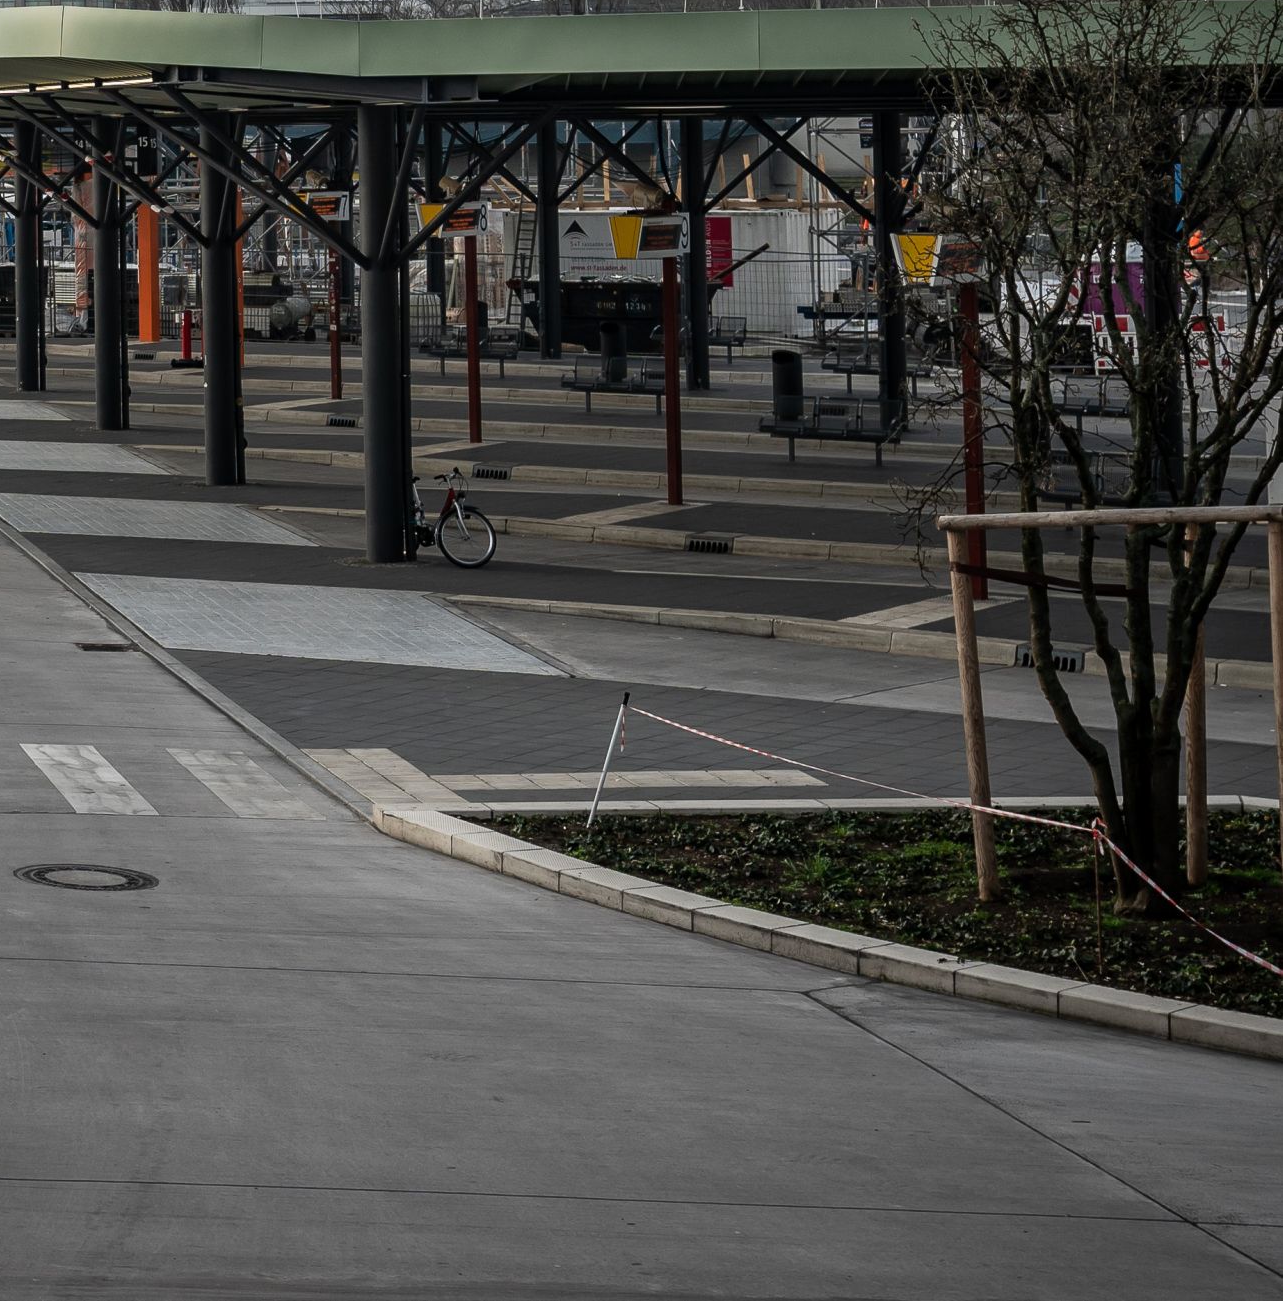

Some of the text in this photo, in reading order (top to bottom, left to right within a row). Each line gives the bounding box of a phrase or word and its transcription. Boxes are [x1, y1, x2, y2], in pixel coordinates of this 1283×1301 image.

[138, 137, 148, 147] 15
[341, 194, 348, 218] 7
[480, 204, 488, 231] 8
[681, 216, 689, 249] 9
